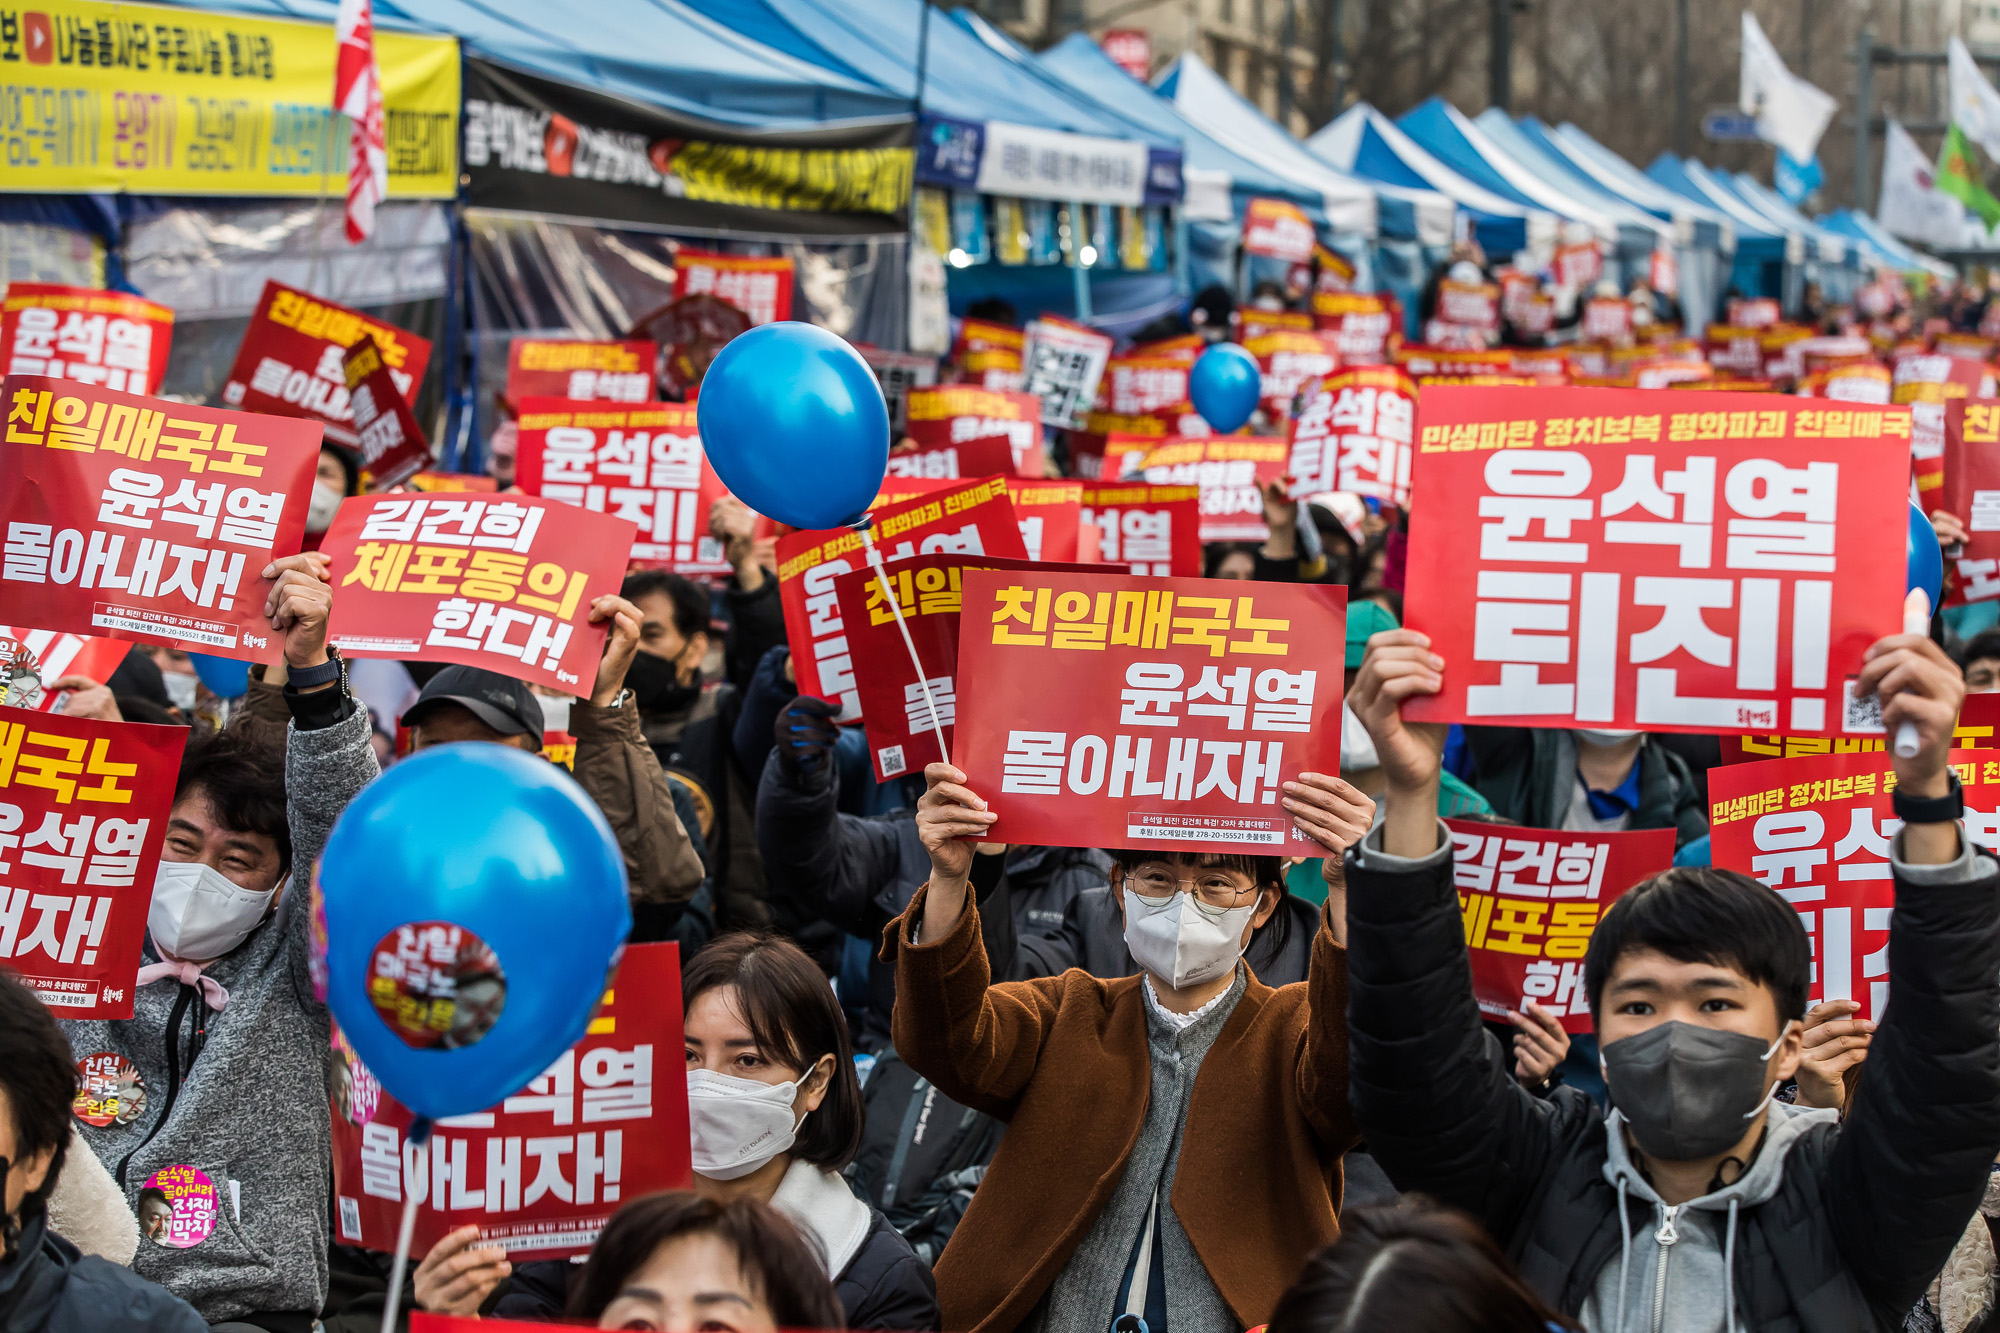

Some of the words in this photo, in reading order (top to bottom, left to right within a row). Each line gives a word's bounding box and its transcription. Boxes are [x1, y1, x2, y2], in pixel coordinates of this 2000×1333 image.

[14, 307, 153, 372] 윤석열
[5, 387, 269, 477] 친일매국노
[542, 426, 702, 489] 윤석열
[1420, 420, 1538, 455] 민생파탄
[1544, 413, 1663, 449] 정치보복
[1667, 410, 1789, 444] 평화파괴
[1793, 410, 1911, 440] 친일매국
[1287, 433, 1412, 504] 퇴진!
[96, 468, 287, 549] 윤석열
[358, 499, 546, 553] 김건희
[880, 500, 943, 541] 평화파괴
[943, 476, 1008, 518] 친일매국
[1478, 448, 1840, 573] 윤석열
[2, 520, 247, 612] 몰아내자!
[341, 541, 589, 621] 체포동의
[425, 597, 574, 672] 한다!
[991, 585, 1291, 658] 친일매국노
[1466, 571, 1834, 732] 퇴진!
[1119, 661, 1318, 734] 윤석열
[1001, 729, 1284, 806] 몰아내자!
[1712, 790, 1786, 826] 민생파탄
[1788, 772, 1877, 808] 정치보복
[1139, 827, 1153, 836] 후원
[1196, 830, 1245, 841] 278-20-155521
[1142, 815, 1163, 825] 윤석열
[1164, 816, 1180, 826] 퇴진!
[1181, 817, 1202, 827] 김건희
[1220, 818, 1236, 829] 29차
[1452, 831, 1611, 900] 김건희
[86, 1056, 120, 1077] 친일
[156, 1166, 196, 1186] 윤석열
[164, 1183, 213, 1200] 끌어내려
[361, 1121, 623, 1214] 몰아내자!
[172, 1219, 211, 1241] 막자
[173, 1197, 217, 1220] 전쟁을
